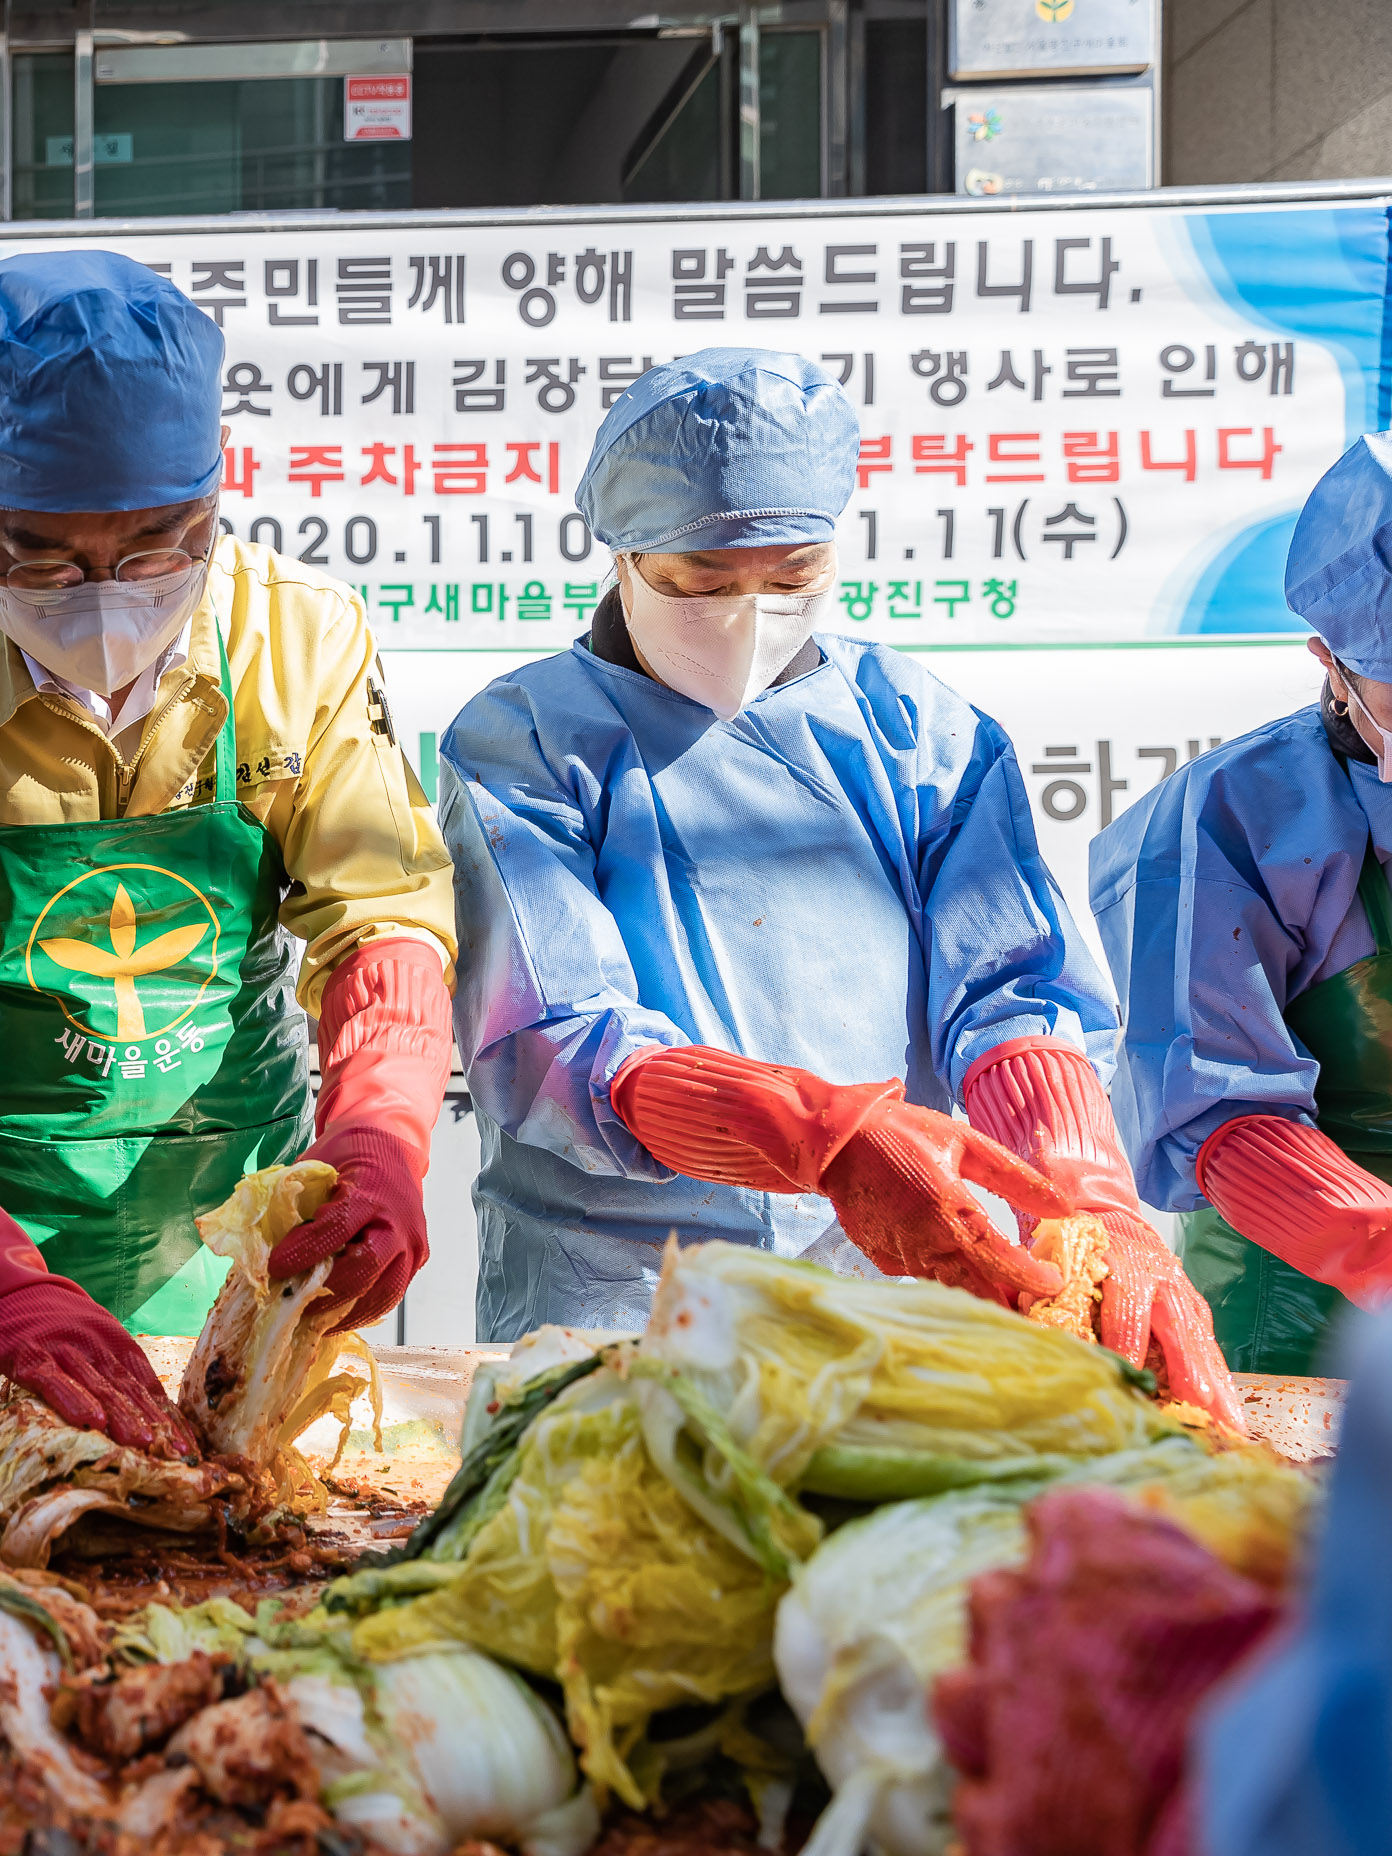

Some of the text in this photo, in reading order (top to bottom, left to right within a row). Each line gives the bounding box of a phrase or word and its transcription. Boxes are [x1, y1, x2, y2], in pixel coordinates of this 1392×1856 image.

[145, 235, 1144, 328] 주민들께 양해 말씀드립니다.
[910, 346, 1122, 407] 행사로
[1160, 339, 1298, 398] 인해
[288, 440, 560, 498] 주차금지
[839, 577, 1020, 621] 광진구청
[54, 1021, 207, 1080] 새마을운동
